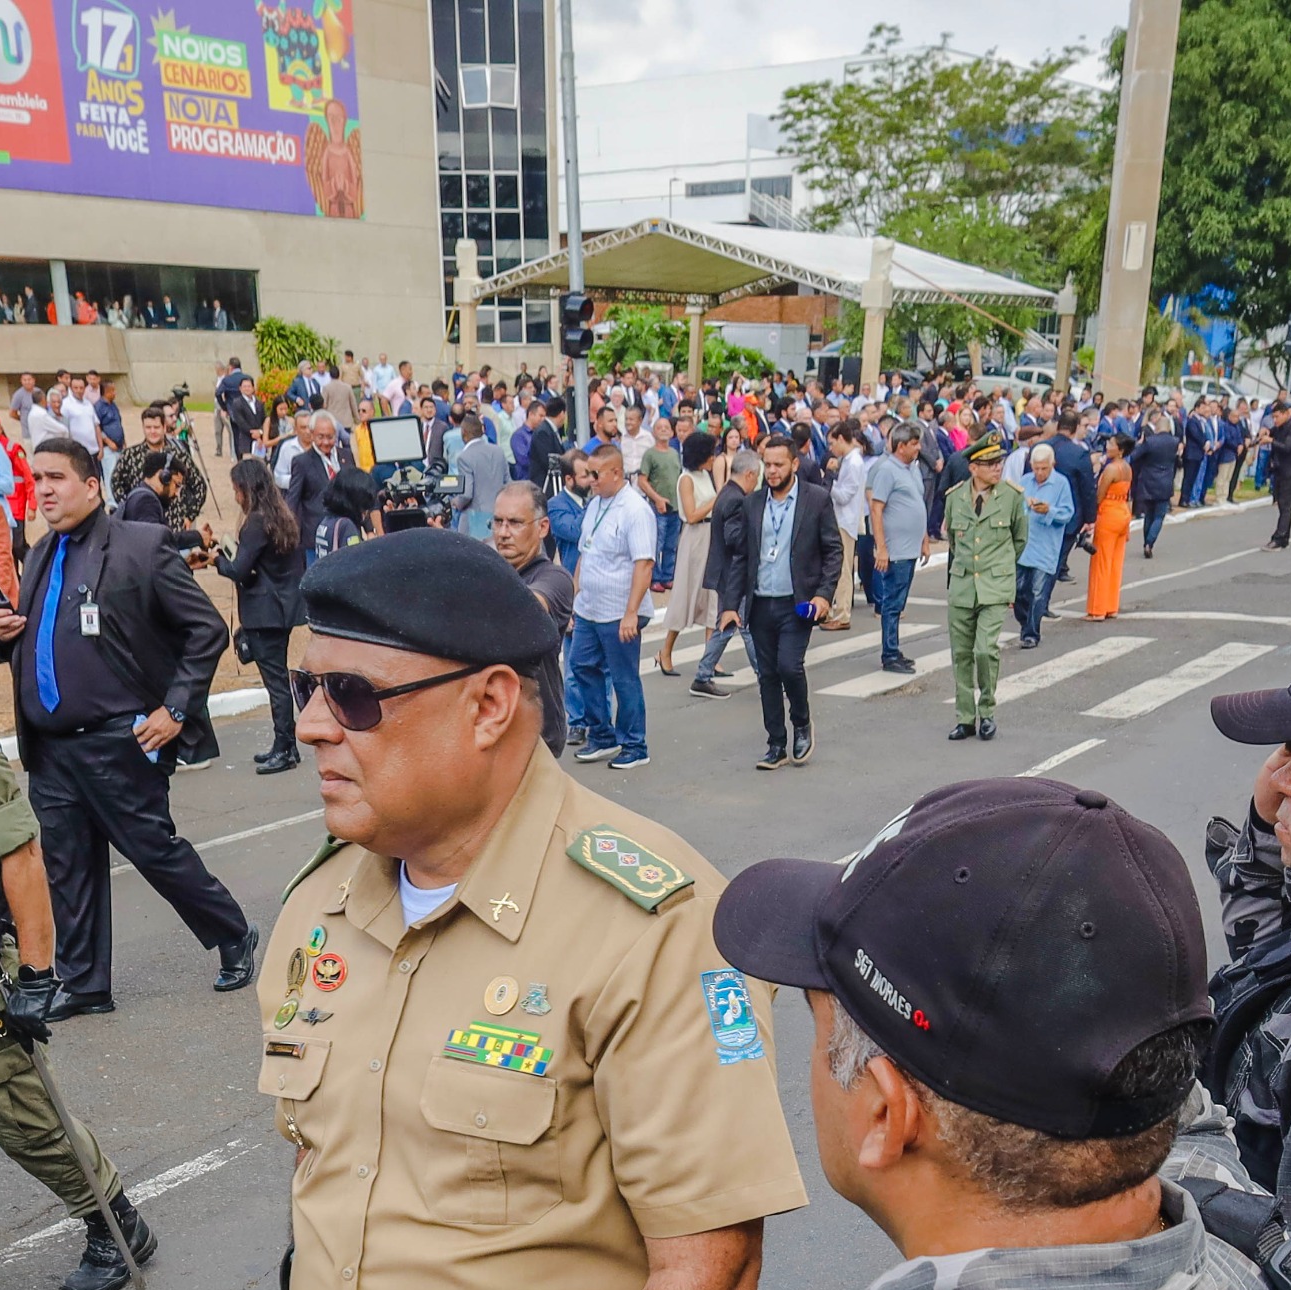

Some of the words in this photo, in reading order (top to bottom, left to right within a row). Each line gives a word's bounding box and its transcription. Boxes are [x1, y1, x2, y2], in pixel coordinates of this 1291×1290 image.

[162, 33, 243, 67] NOVOS
[86, 67, 146, 116] ANOS
[163, 61, 247, 94] CENÁRIOS
[79, 101, 131, 127] FEITA
[168, 95, 233, 126] NOVA
[76, 123, 104, 138] PARA
[103, 119, 150, 154] VOCÊ
[169, 122, 297, 164] PROGRAMAÇÃO
[854, 948, 874, 980] SGT
[870, 967, 912, 1020] MORAES
